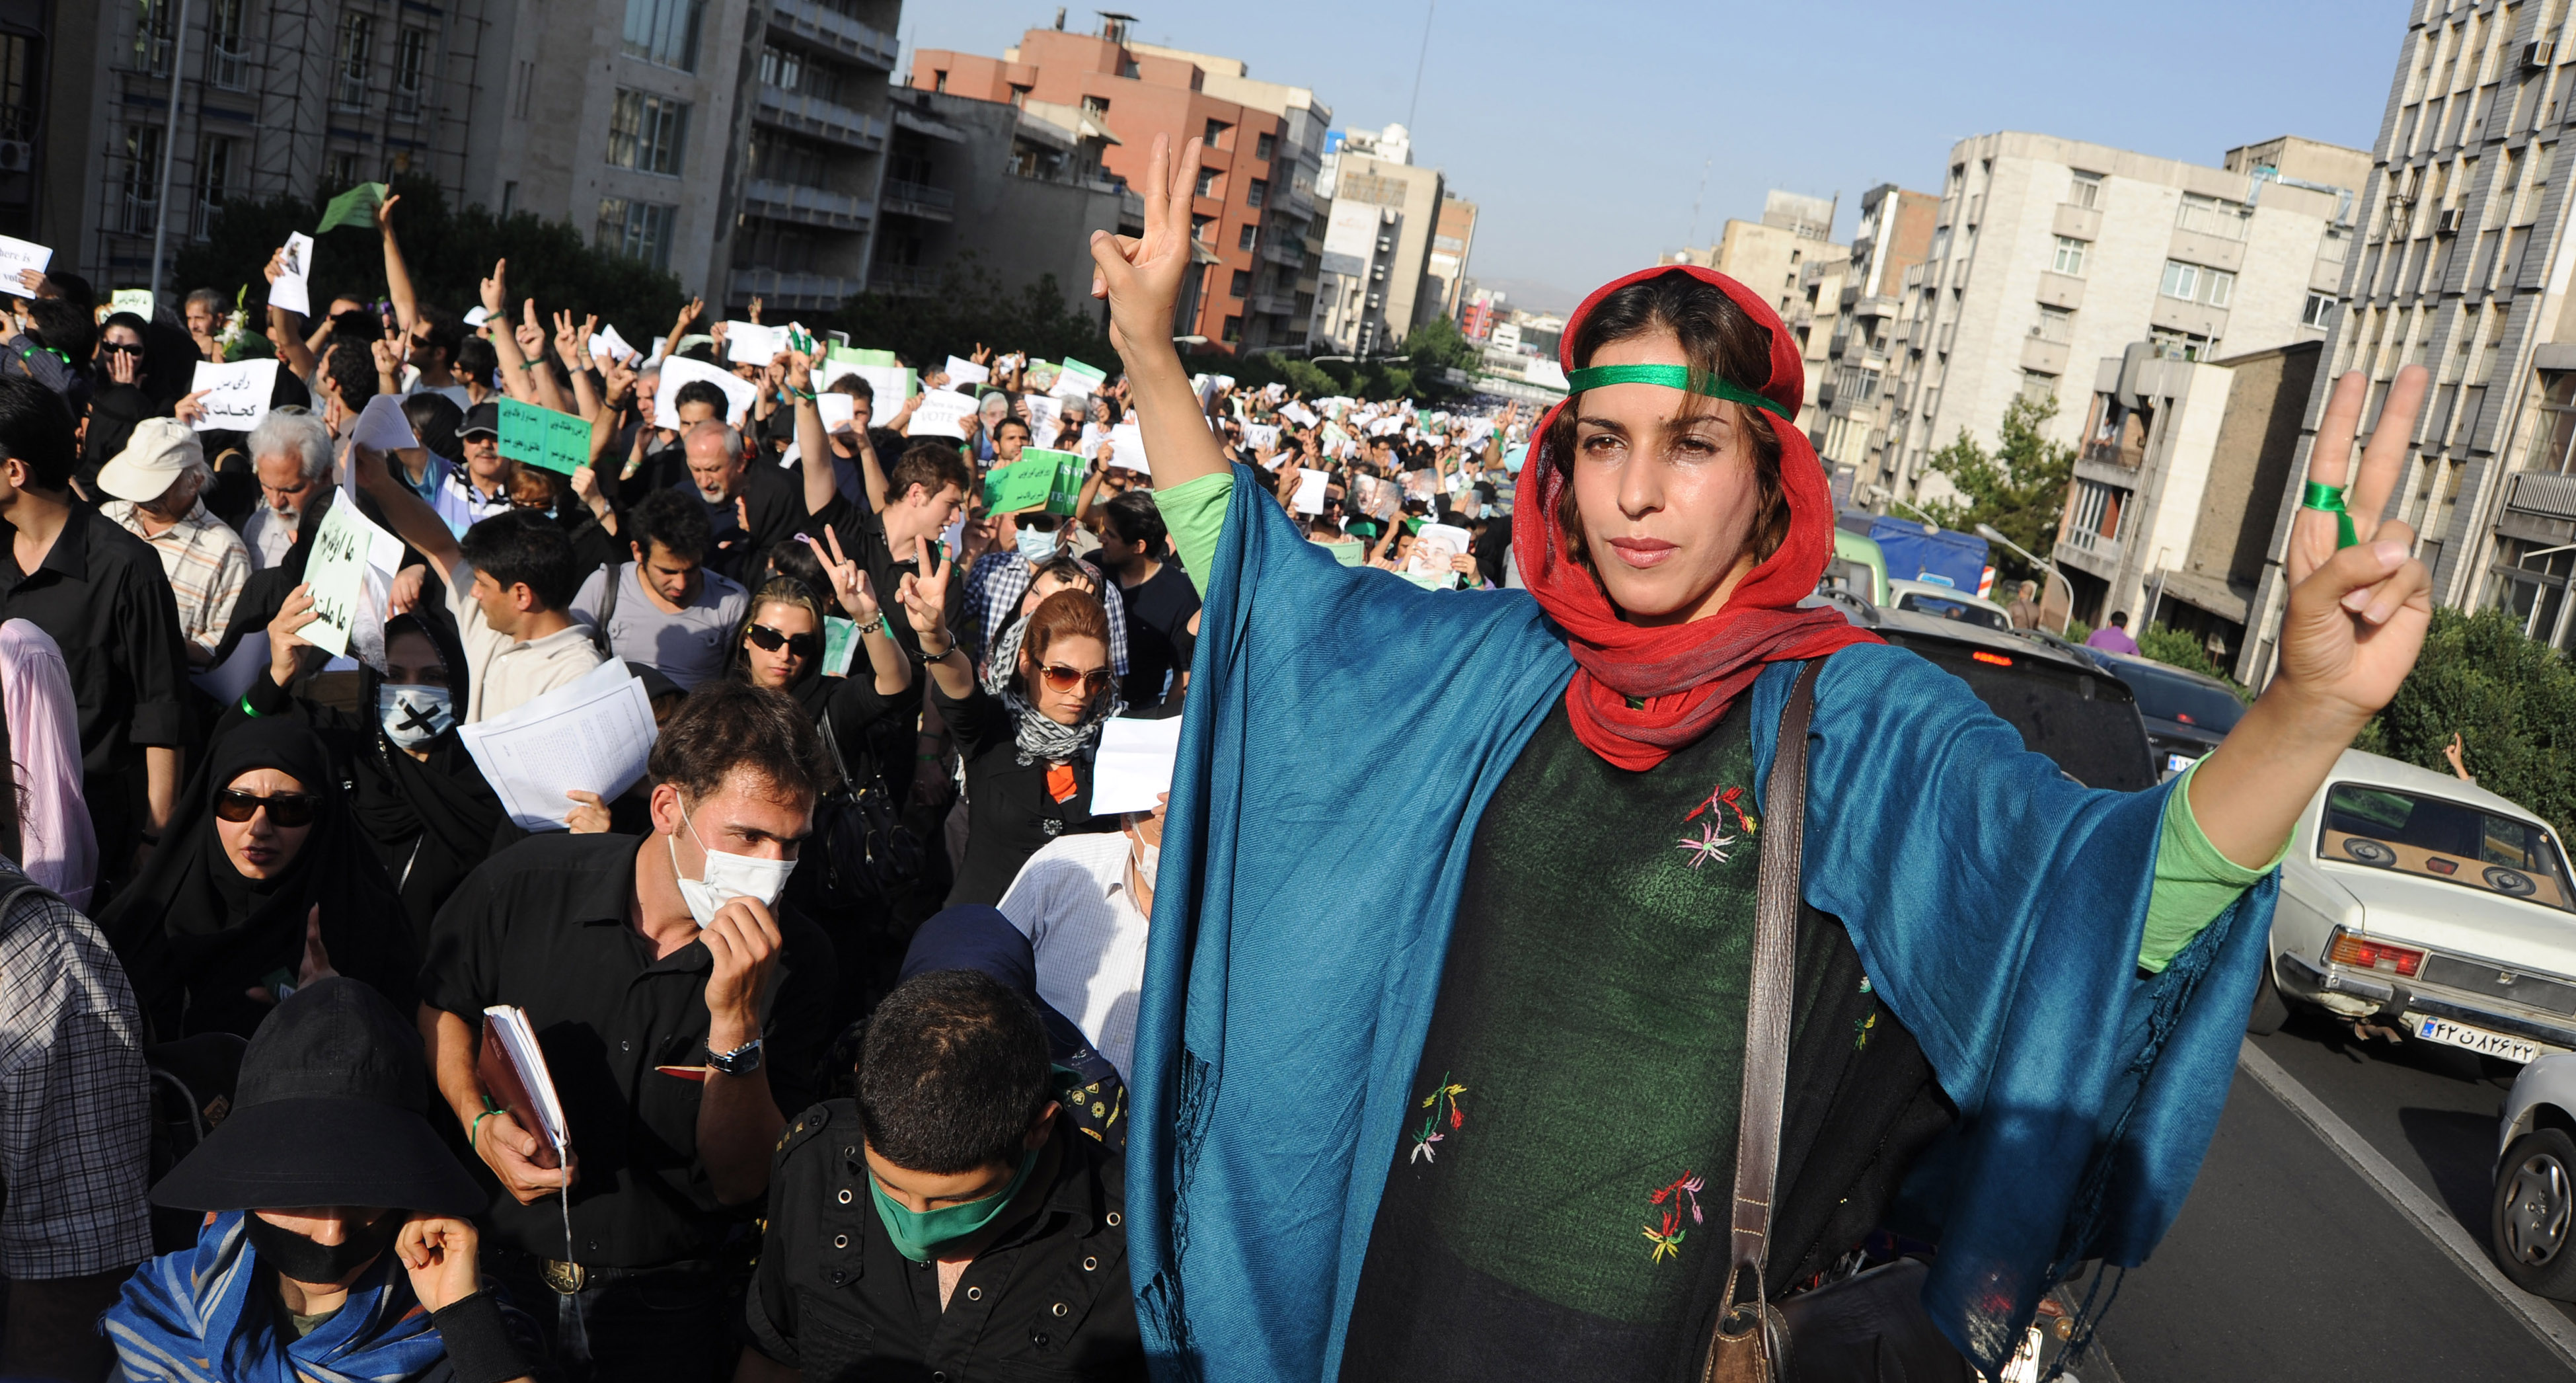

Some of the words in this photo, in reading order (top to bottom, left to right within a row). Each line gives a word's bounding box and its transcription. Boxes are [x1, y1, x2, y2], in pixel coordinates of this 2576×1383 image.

[22, 253, 31, 262] is
[213, 402, 256, 421] کجاست
[2435, 1023, 2459, 1041] ۴۲
[2476, 1035, 2511, 1053] ۸۲۶
[2513, 1044, 2533, 1060] ۲۲
